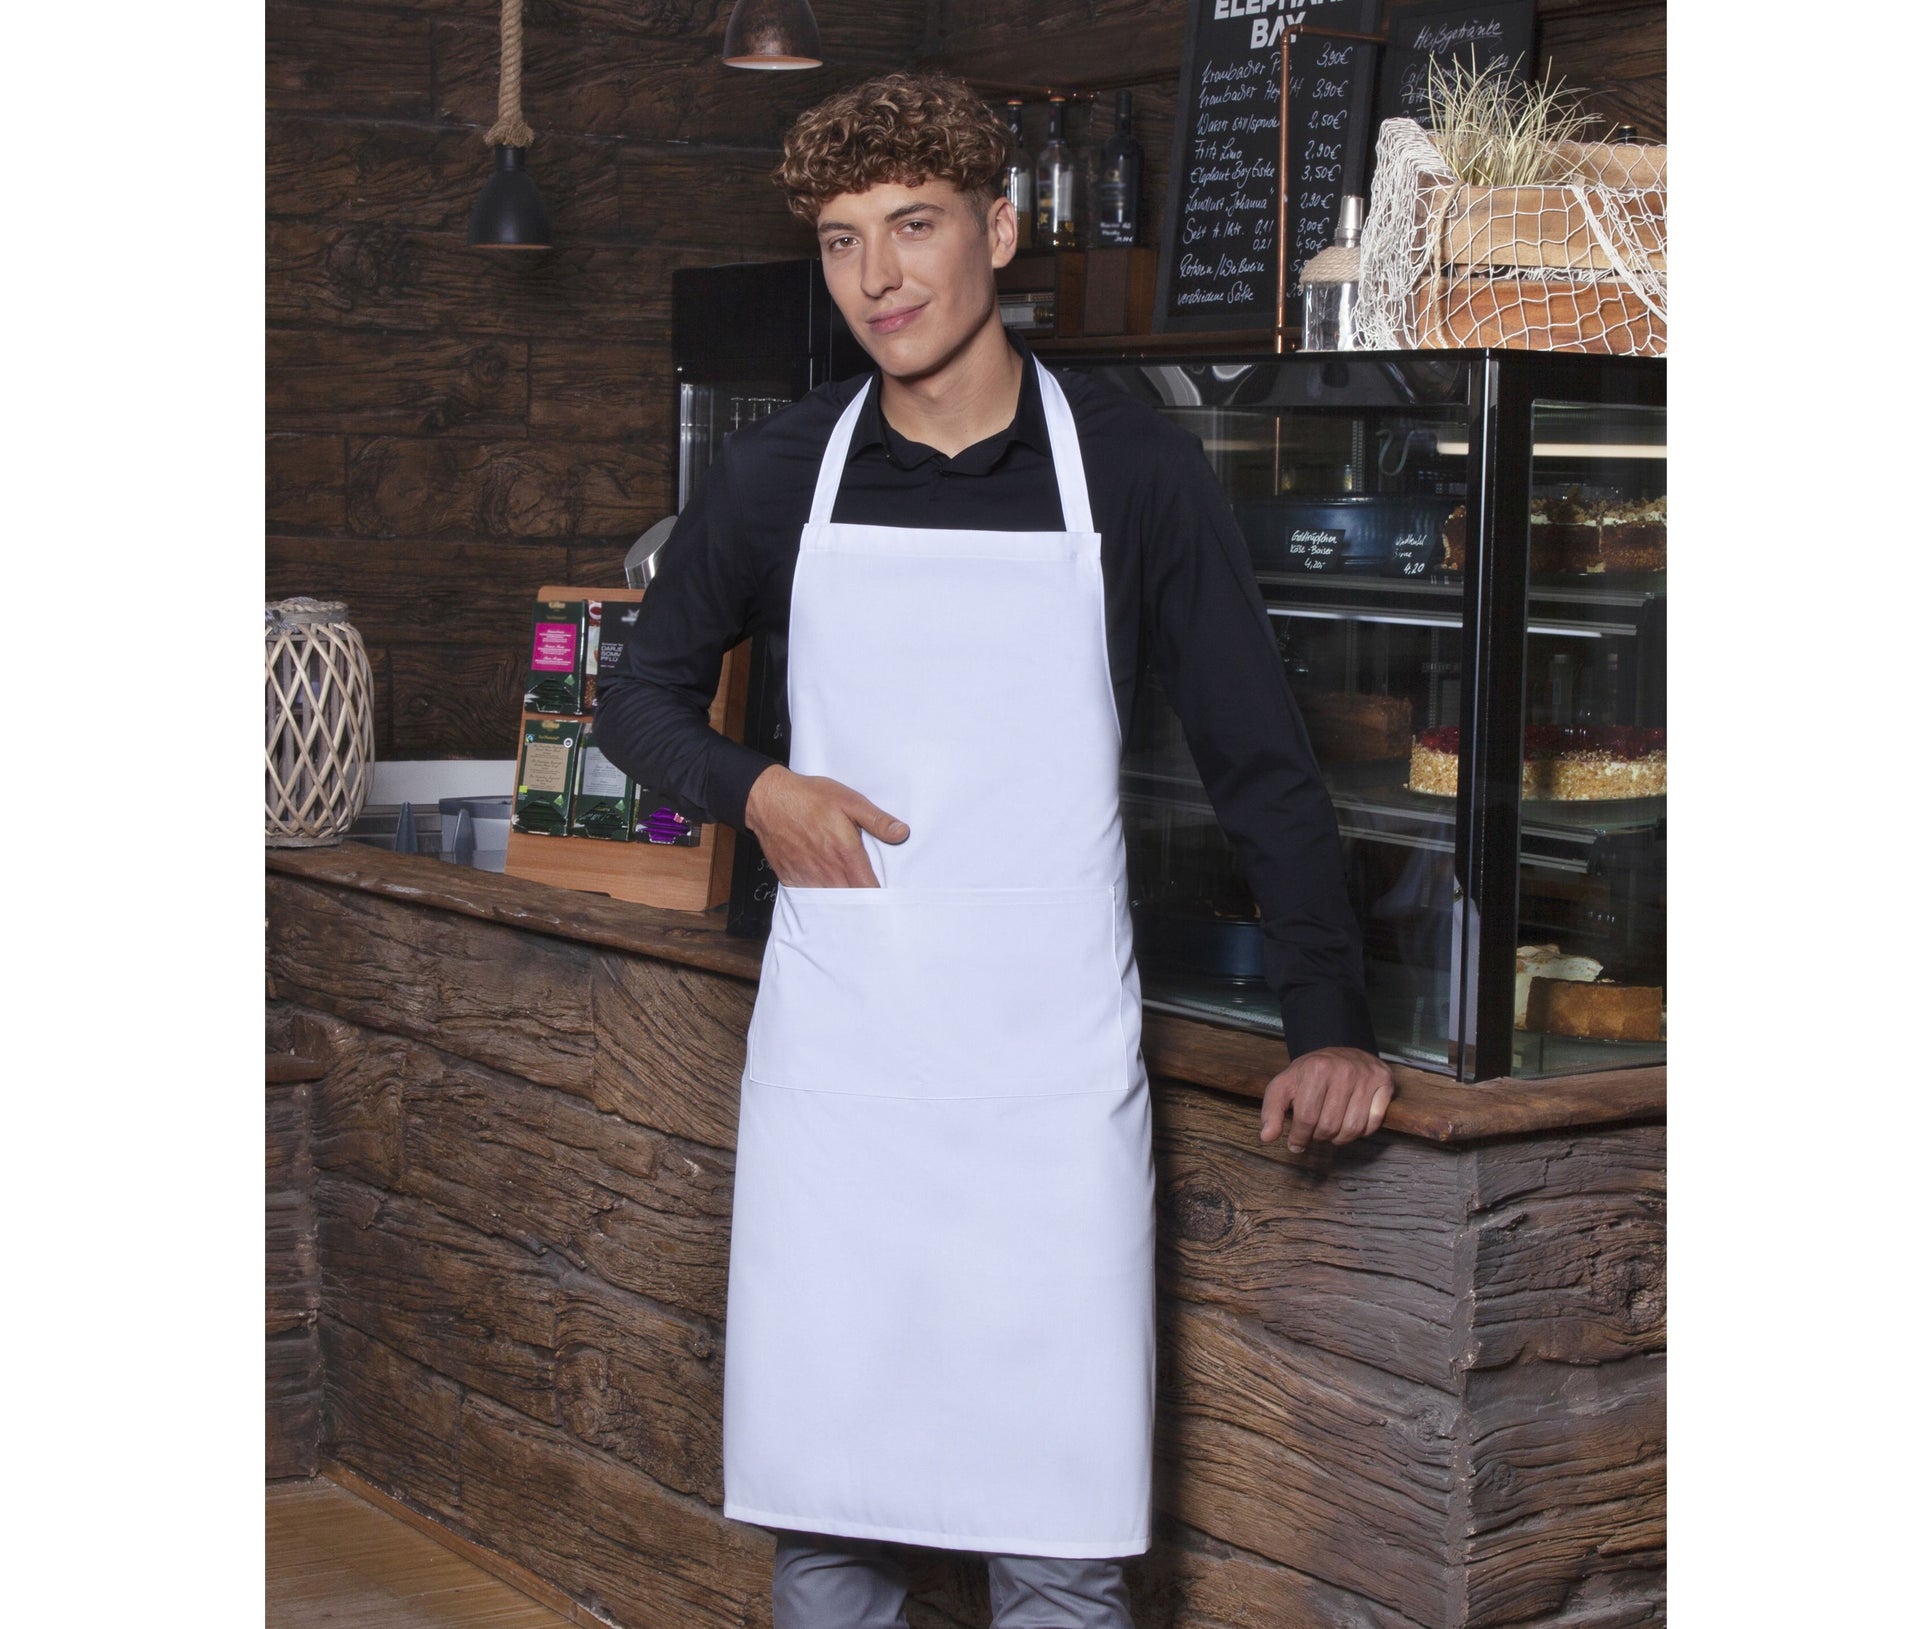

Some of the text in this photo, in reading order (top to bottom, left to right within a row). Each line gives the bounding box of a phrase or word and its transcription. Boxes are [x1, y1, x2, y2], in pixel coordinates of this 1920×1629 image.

[1250, 12, 1307, 49] BAY
[1316, 42, 1353, 68] 3,90€
[1312, 78, 1349, 99] 3,90€
[1308, 110, 1348, 130] 2,50€
[1219, 137, 1243, 161] Limo
[1304, 139, 1342, 160] 2,90€
[1190, 166, 1231, 188] Elephant
[1231, 160, 1252, 190] Bay
[1301, 164, 1342, 183] 3,50€
[1297, 217, 1330, 235] 3,00€
[1403, 562, 1426, 576] 4,20
